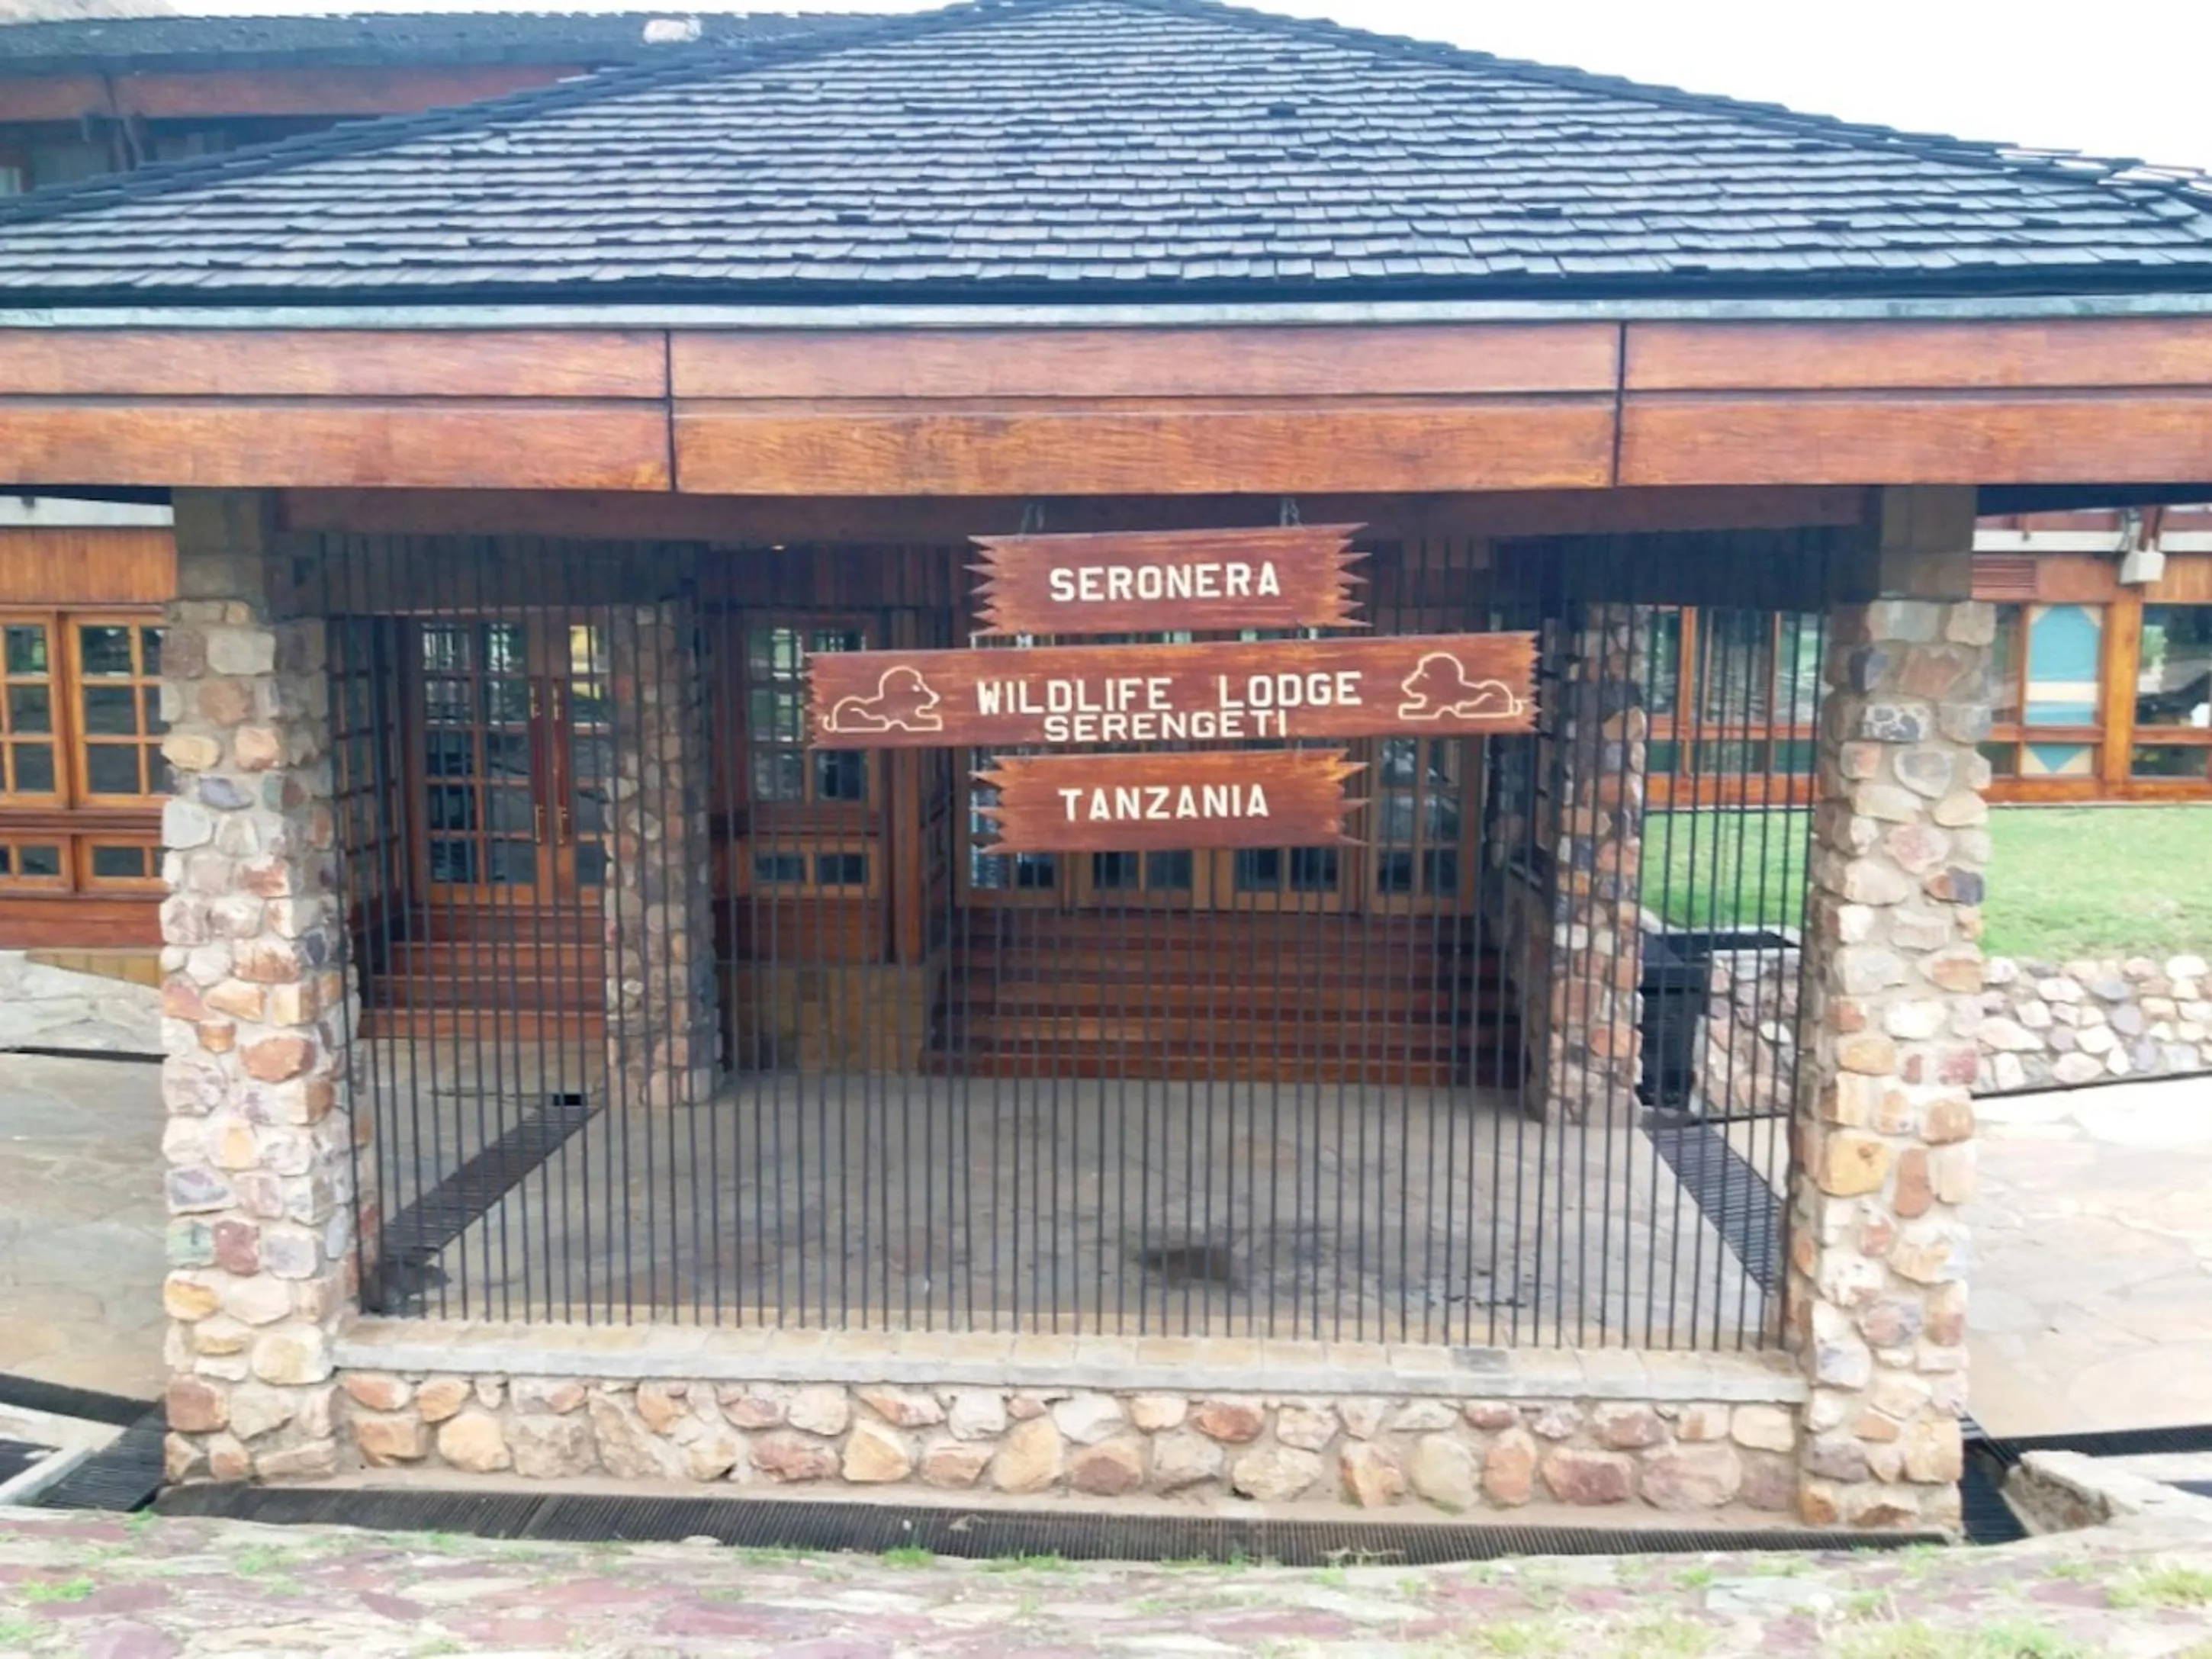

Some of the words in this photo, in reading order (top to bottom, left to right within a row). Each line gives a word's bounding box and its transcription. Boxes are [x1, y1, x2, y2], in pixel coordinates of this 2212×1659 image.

[1050, 561, 1281, 603] SERONERA
[976, 677, 1173, 716] WILDLIFE
[1218, 670, 1363, 710] LODGE
[1043, 709, 1289, 742] SERENGETI
[1058, 783, 1270, 822] TANZANIA
